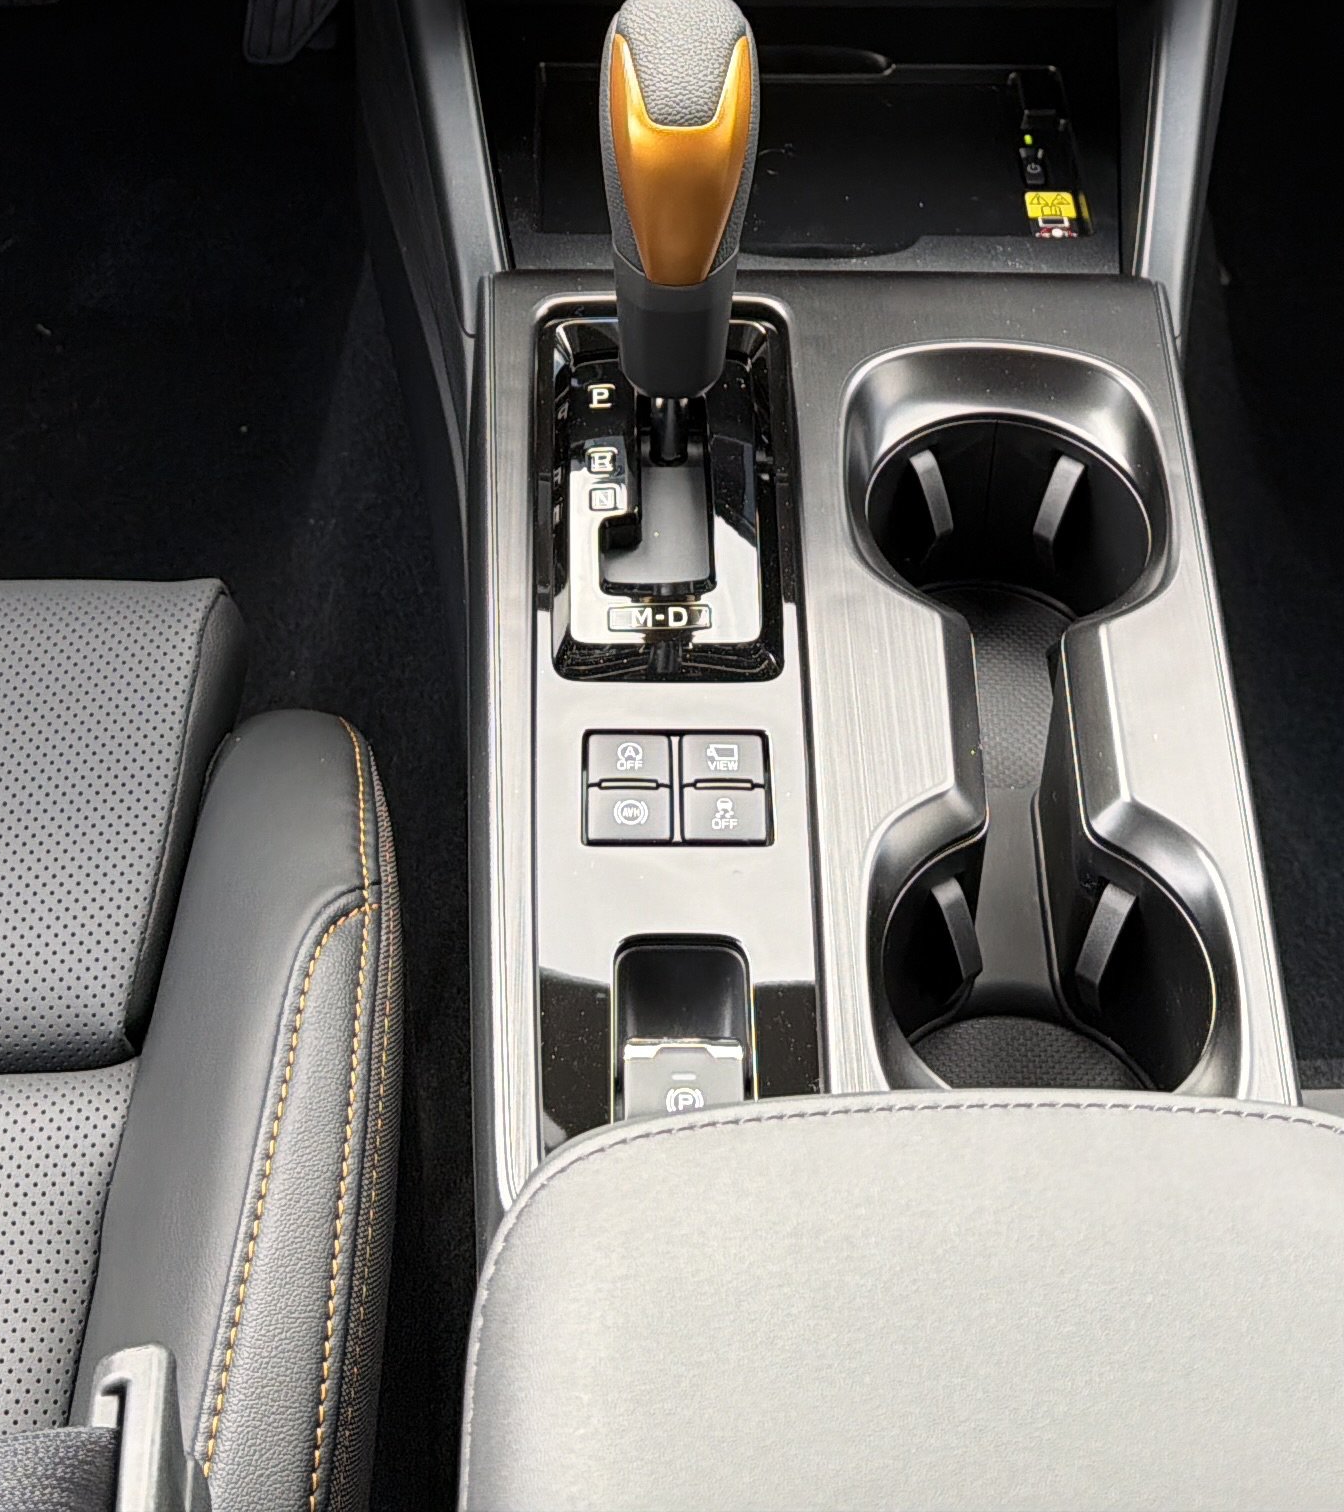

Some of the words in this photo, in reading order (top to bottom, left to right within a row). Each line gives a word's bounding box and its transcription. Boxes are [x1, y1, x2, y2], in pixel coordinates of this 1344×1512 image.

[591, 387, 610, 406] P
[617, 760, 643, 771] OFF
[707, 761, 738, 771] VIEW
[622, 806, 641, 818] AVH
[712, 819, 738, 829] OFF
